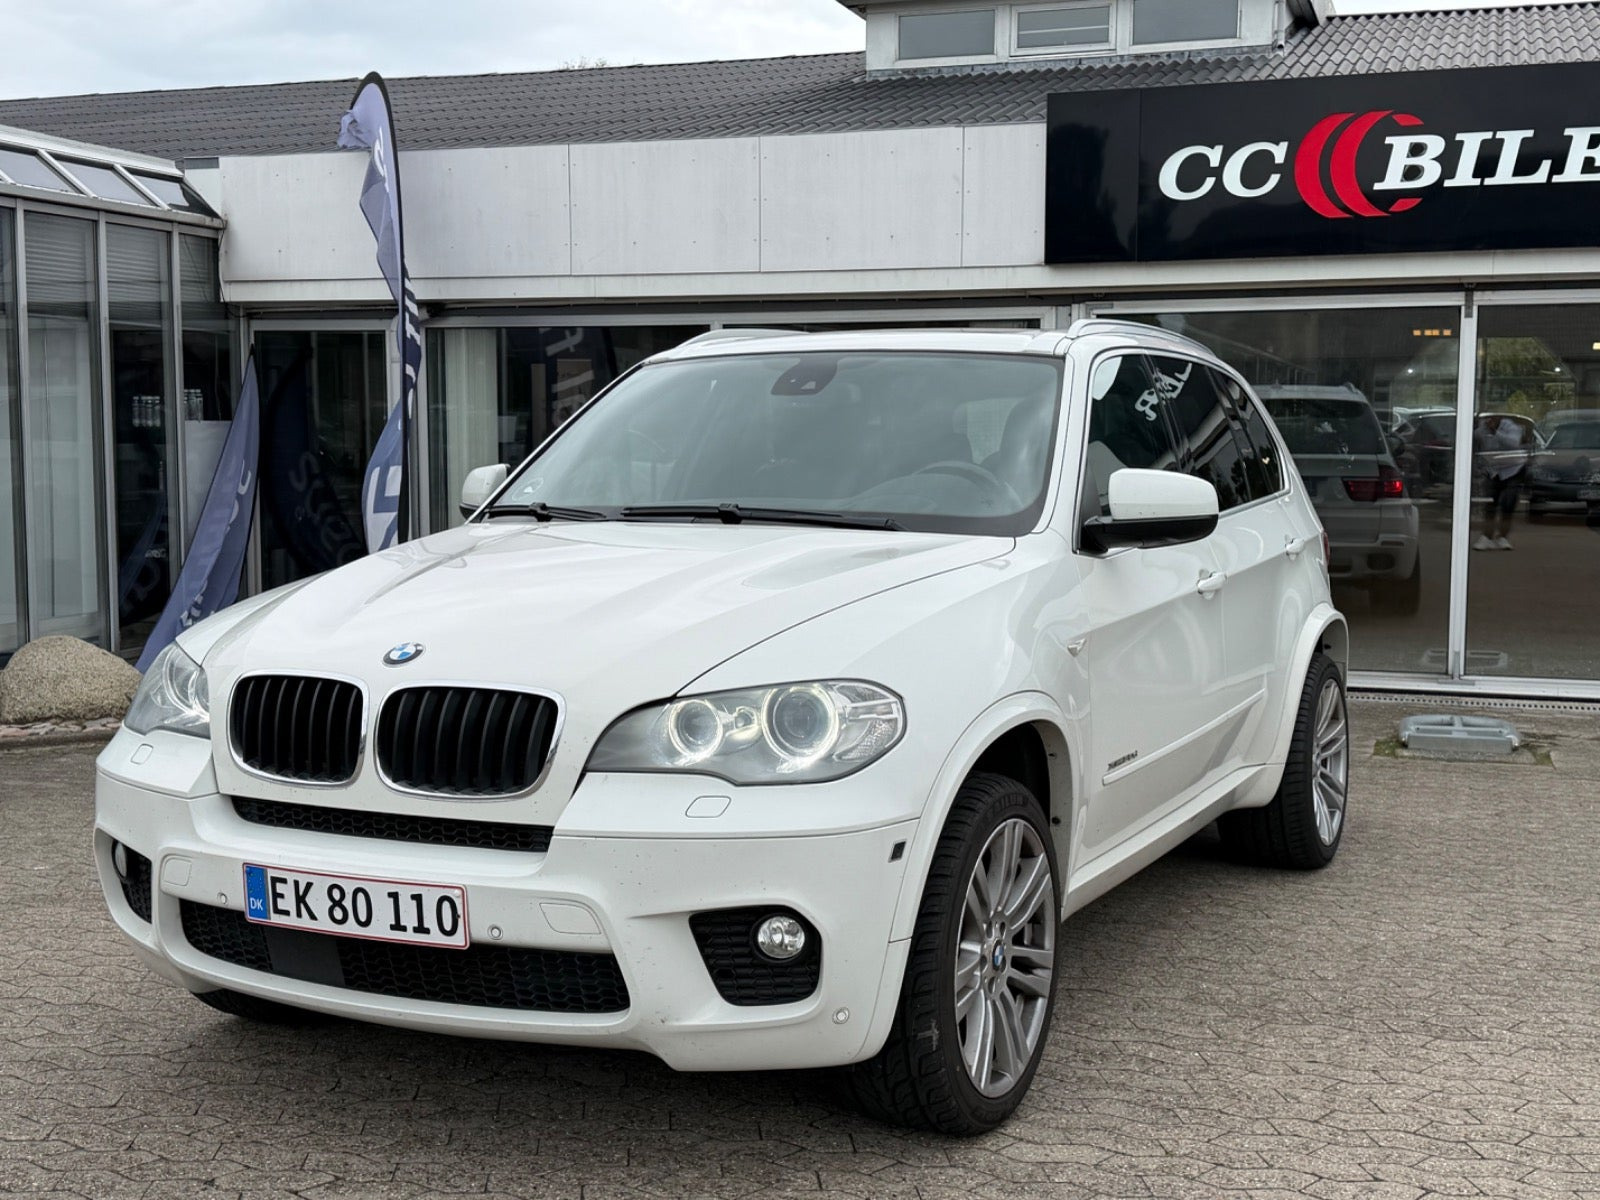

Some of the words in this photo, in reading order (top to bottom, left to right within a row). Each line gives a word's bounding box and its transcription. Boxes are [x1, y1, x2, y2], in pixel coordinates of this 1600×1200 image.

[1158, 141, 1288, 201] CC
[1373, 126, 1600, 191] BILE
[250, 897, 263, 911] DK
[270, 875, 318, 922] EK
[326, 883, 373, 928] 80
[387, 891, 459, 937] 110
